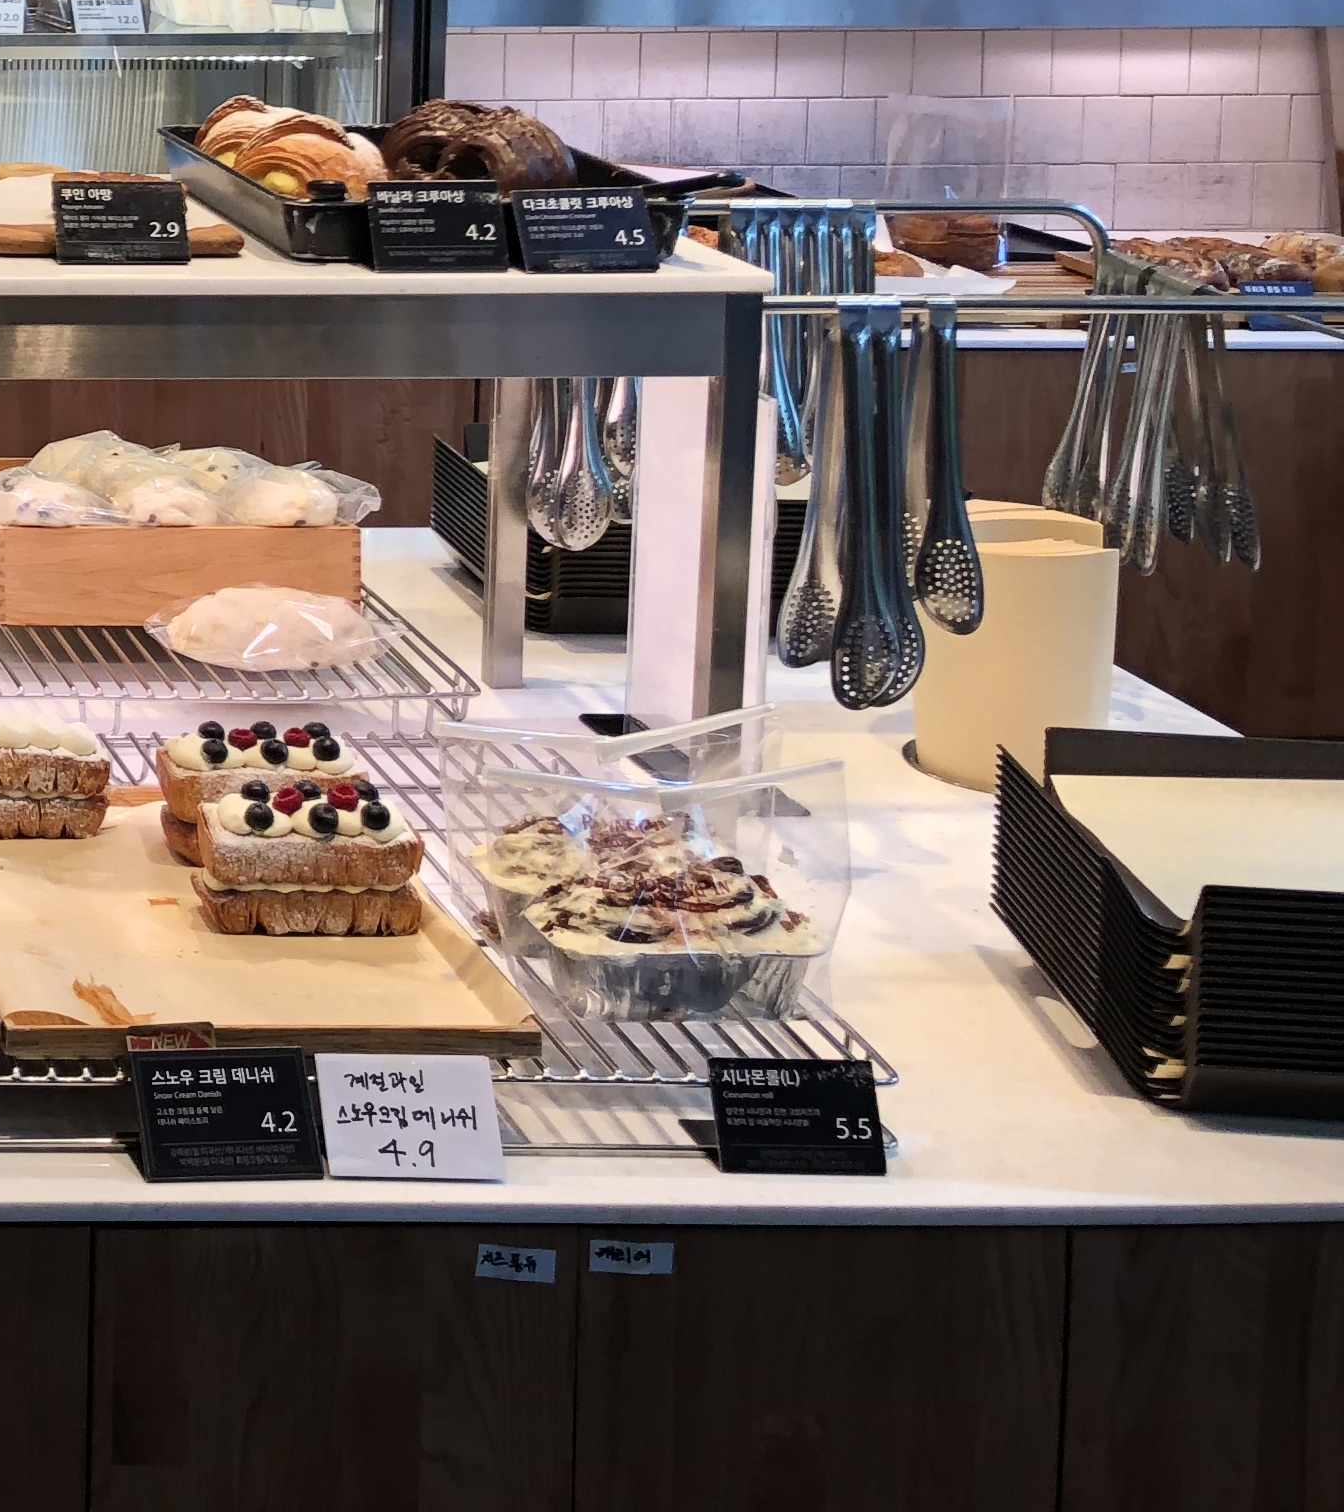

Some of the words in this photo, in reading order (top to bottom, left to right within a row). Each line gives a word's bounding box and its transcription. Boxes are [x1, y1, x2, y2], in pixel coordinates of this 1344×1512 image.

[117, 16, 138, 24] 12.0
[61, 189, 85, 200] 쿠인
[88, 189, 113, 201] 아망
[376, 190, 413, 204] 바닐라
[416, 190, 466, 204] 크루아상
[586, 196, 633, 209] 크루아상
[149, 221, 181, 237] 2.9
[465, 223, 497, 241] 4.2
[615, 228, 646, 246] 4.5
[151, 1034, 191, 1049] NEW
[151, 1070, 194, 1086] 스노우
[199, 1068, 227, 1084] 크림
[231, 1066, 275, 1084] 데니쉬
[721, 1069, 801, 1087] 시나몬롤(L)
[174, 1091, 196, 1099] Cream
[198, 1090, 222, 1098] Danish
[261, 1111, 297, 1133] 4.2
[836, 1117, 872, 1140] 5.5
[378, 1138, 436, 1168] 4.9
